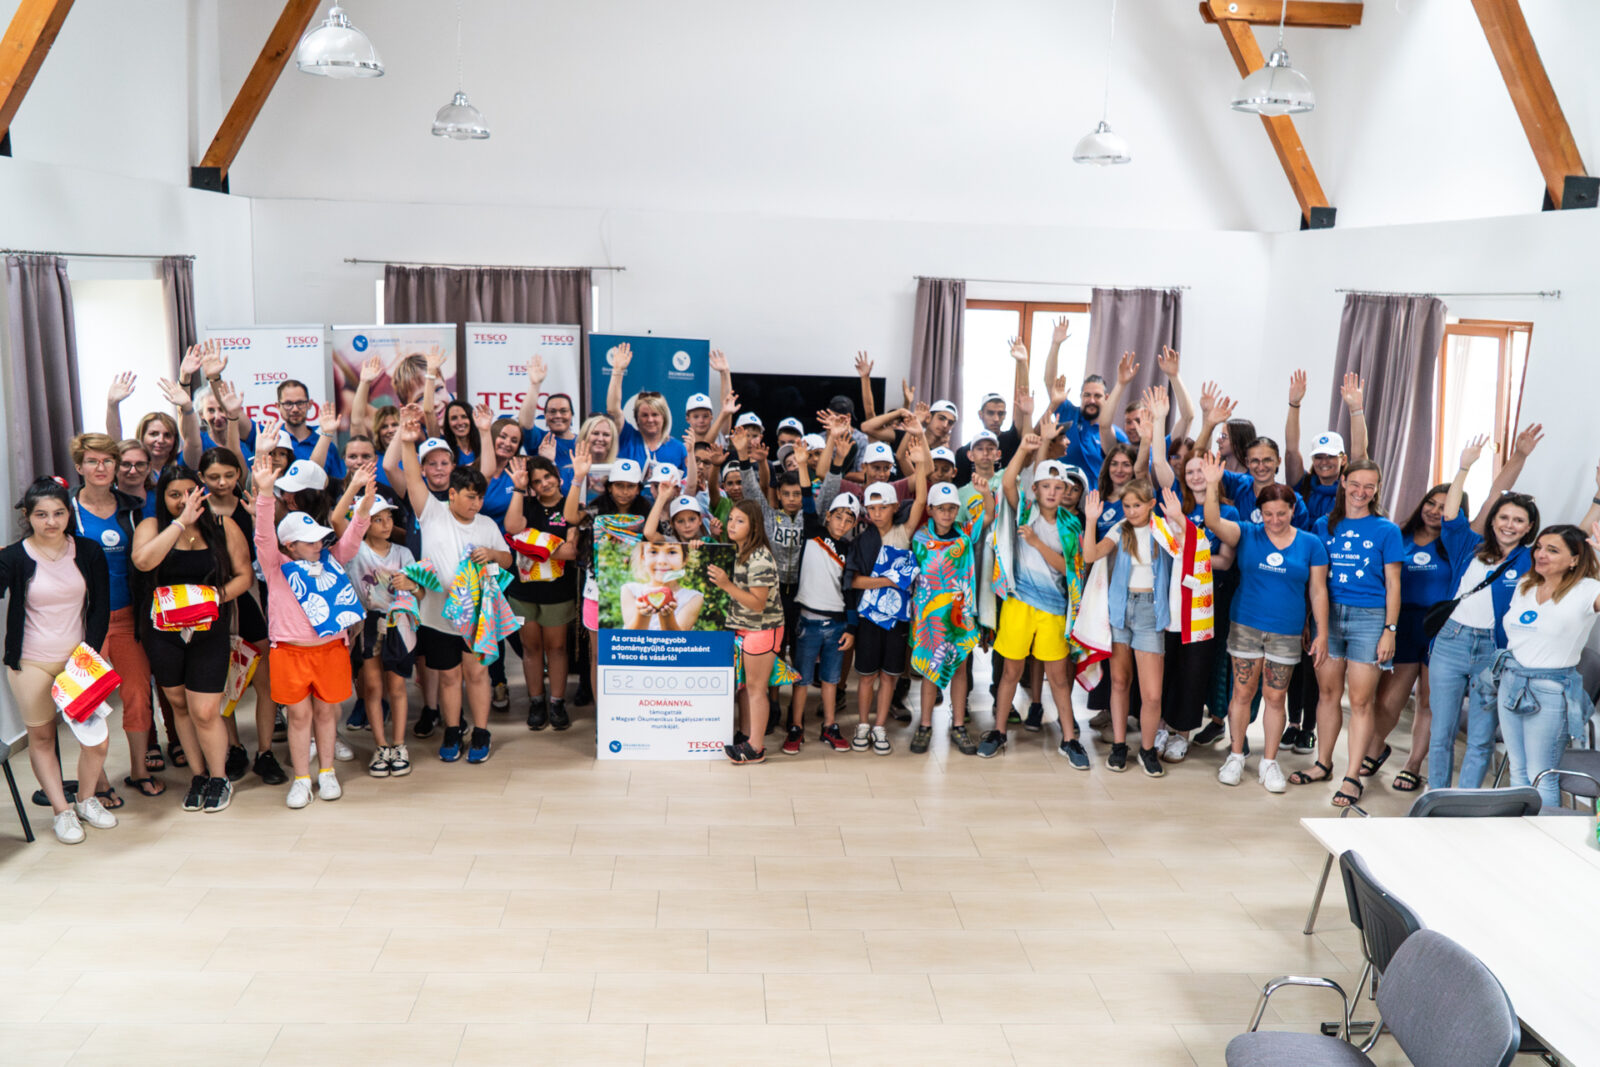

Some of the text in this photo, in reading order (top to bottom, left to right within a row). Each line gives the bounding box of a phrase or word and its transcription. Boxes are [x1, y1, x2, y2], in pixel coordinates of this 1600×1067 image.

[287, 336, 318, 344] TESCO
[474, 334, 507, 342] TESCO
[542, 335, 575, 343] TESCO
[254, 372, 288, 381] TESCO
[476, 391, 571, 411] TESC
[622, 635, 645, 643] ország
[646, 636, 686, 644] legnagyobb
[612, 675, 721, 689] 52 000 000
